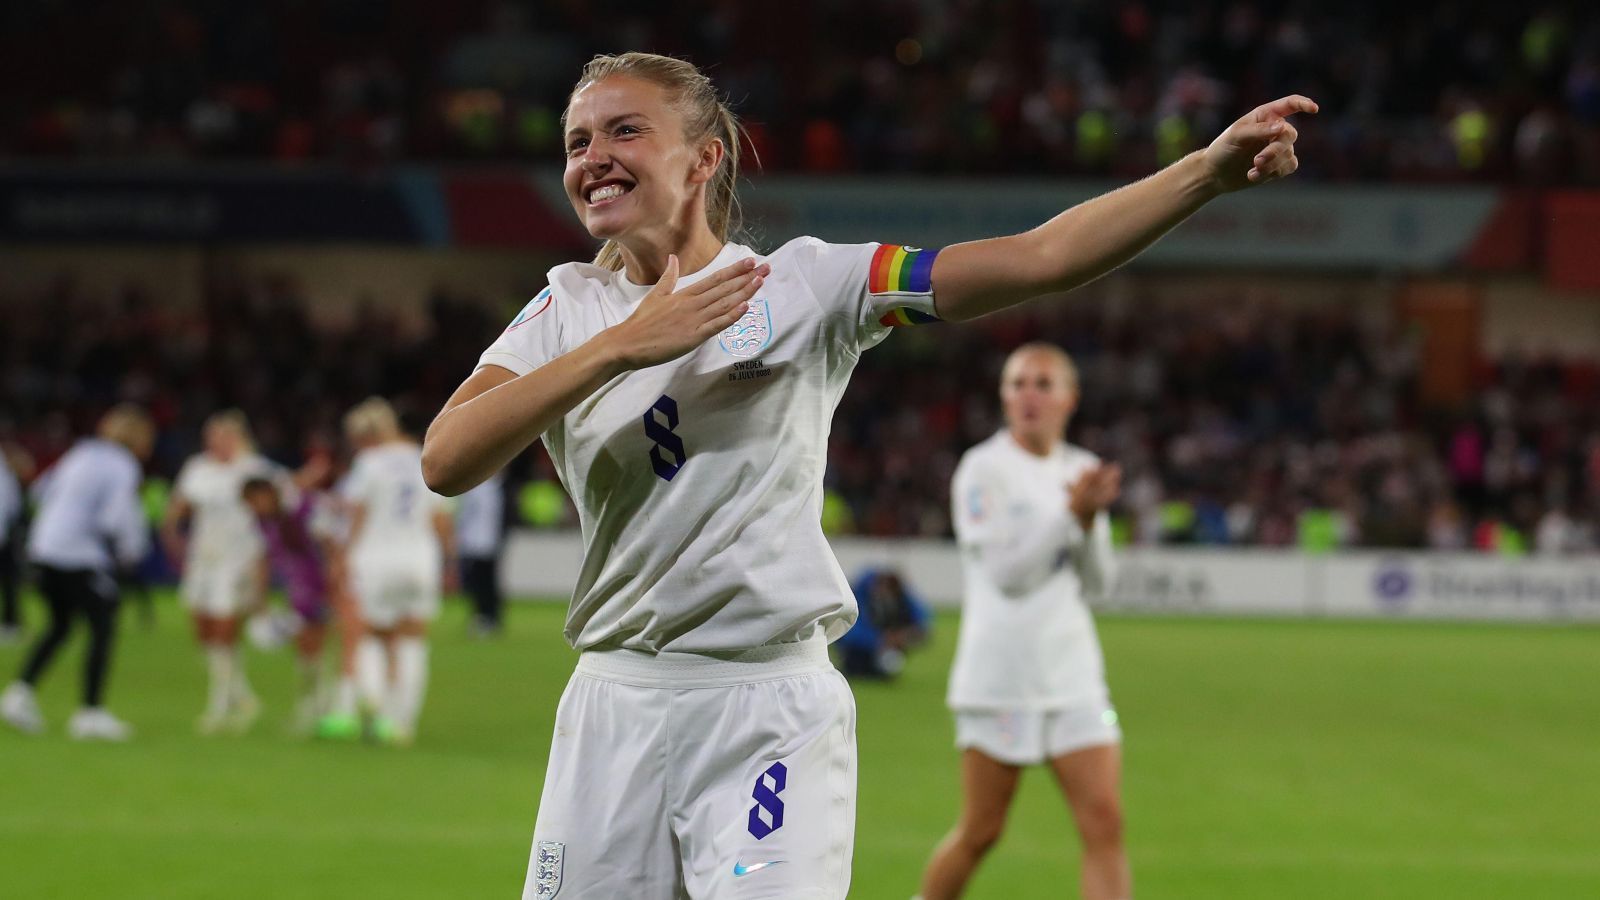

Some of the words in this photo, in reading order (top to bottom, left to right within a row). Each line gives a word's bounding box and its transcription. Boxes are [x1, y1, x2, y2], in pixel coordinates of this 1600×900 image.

[733, 360, 763, 370] SWEDEN
[738, 370, 755, 380] JULY
[643, 394, 687, 482] 8
[748, 761, 788, 840] 8
